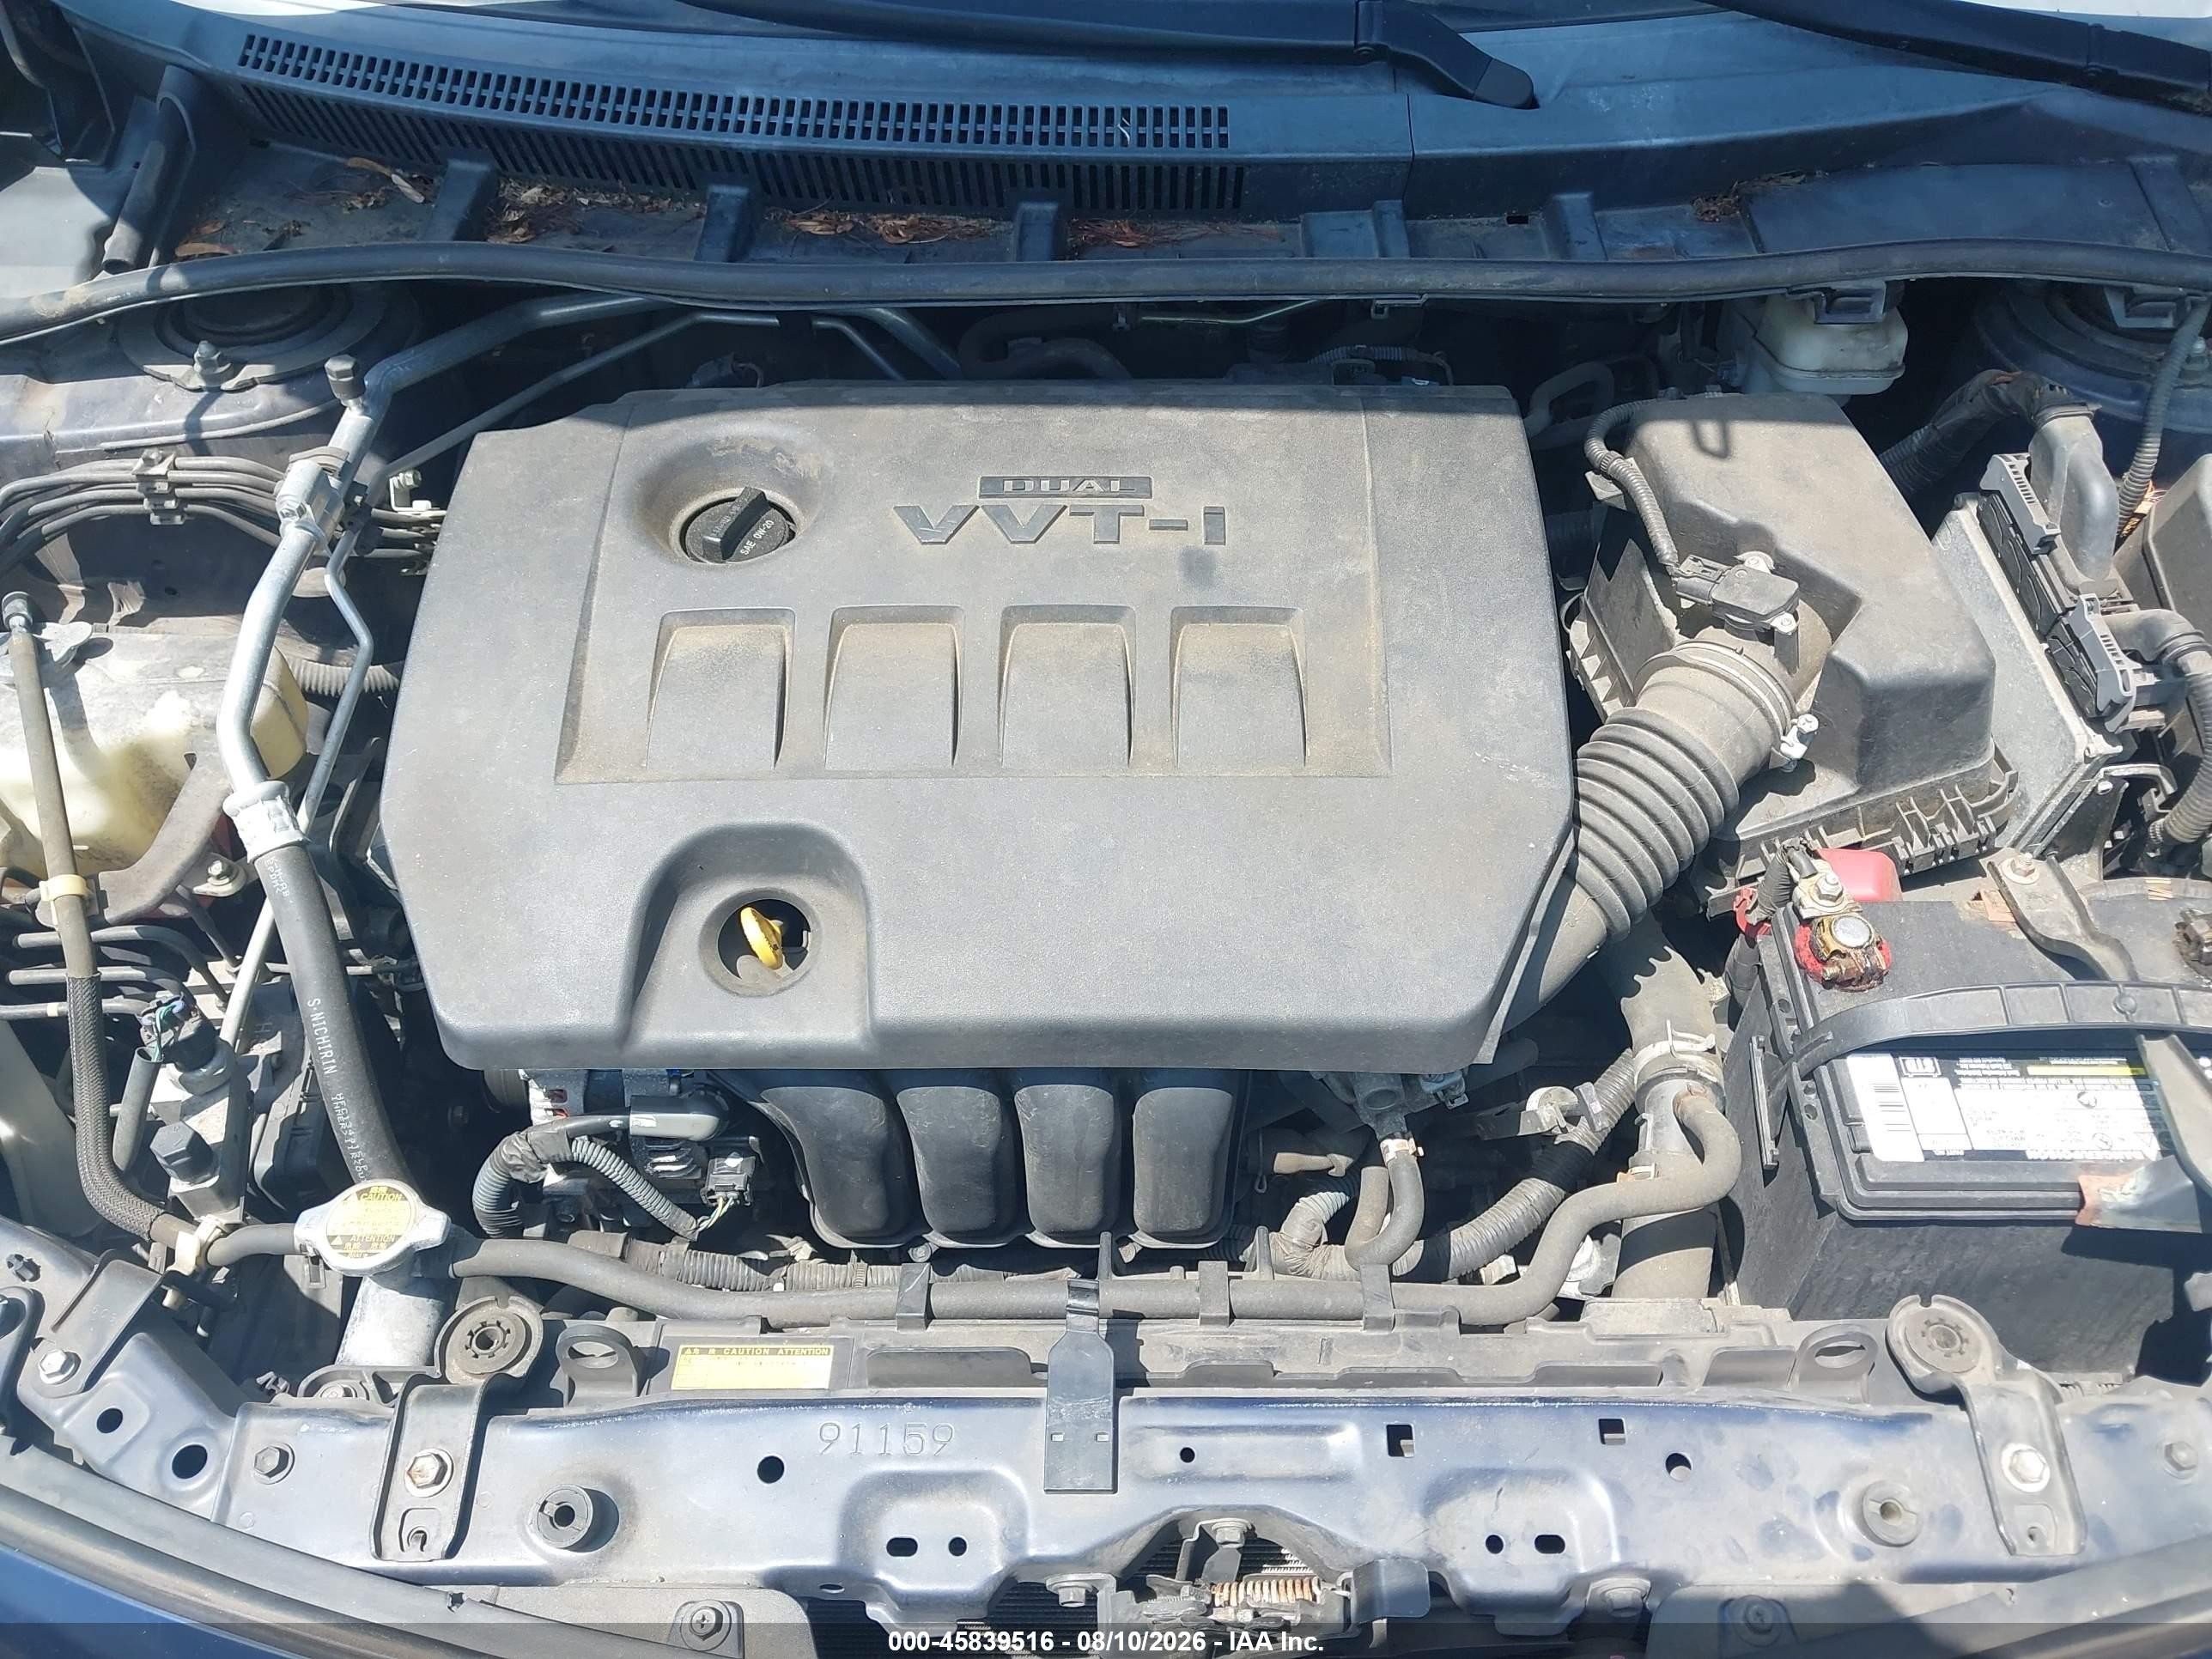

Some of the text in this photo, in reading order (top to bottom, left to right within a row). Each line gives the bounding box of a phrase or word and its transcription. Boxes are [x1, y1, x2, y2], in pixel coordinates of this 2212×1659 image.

[1002, 478, 1137, 493] DUAL
[739, 519, 775, 556] SAE 0W-20
[360, 1192, 404, 1201] CAUTION
[818, 1421, 956, 1457] 91159
